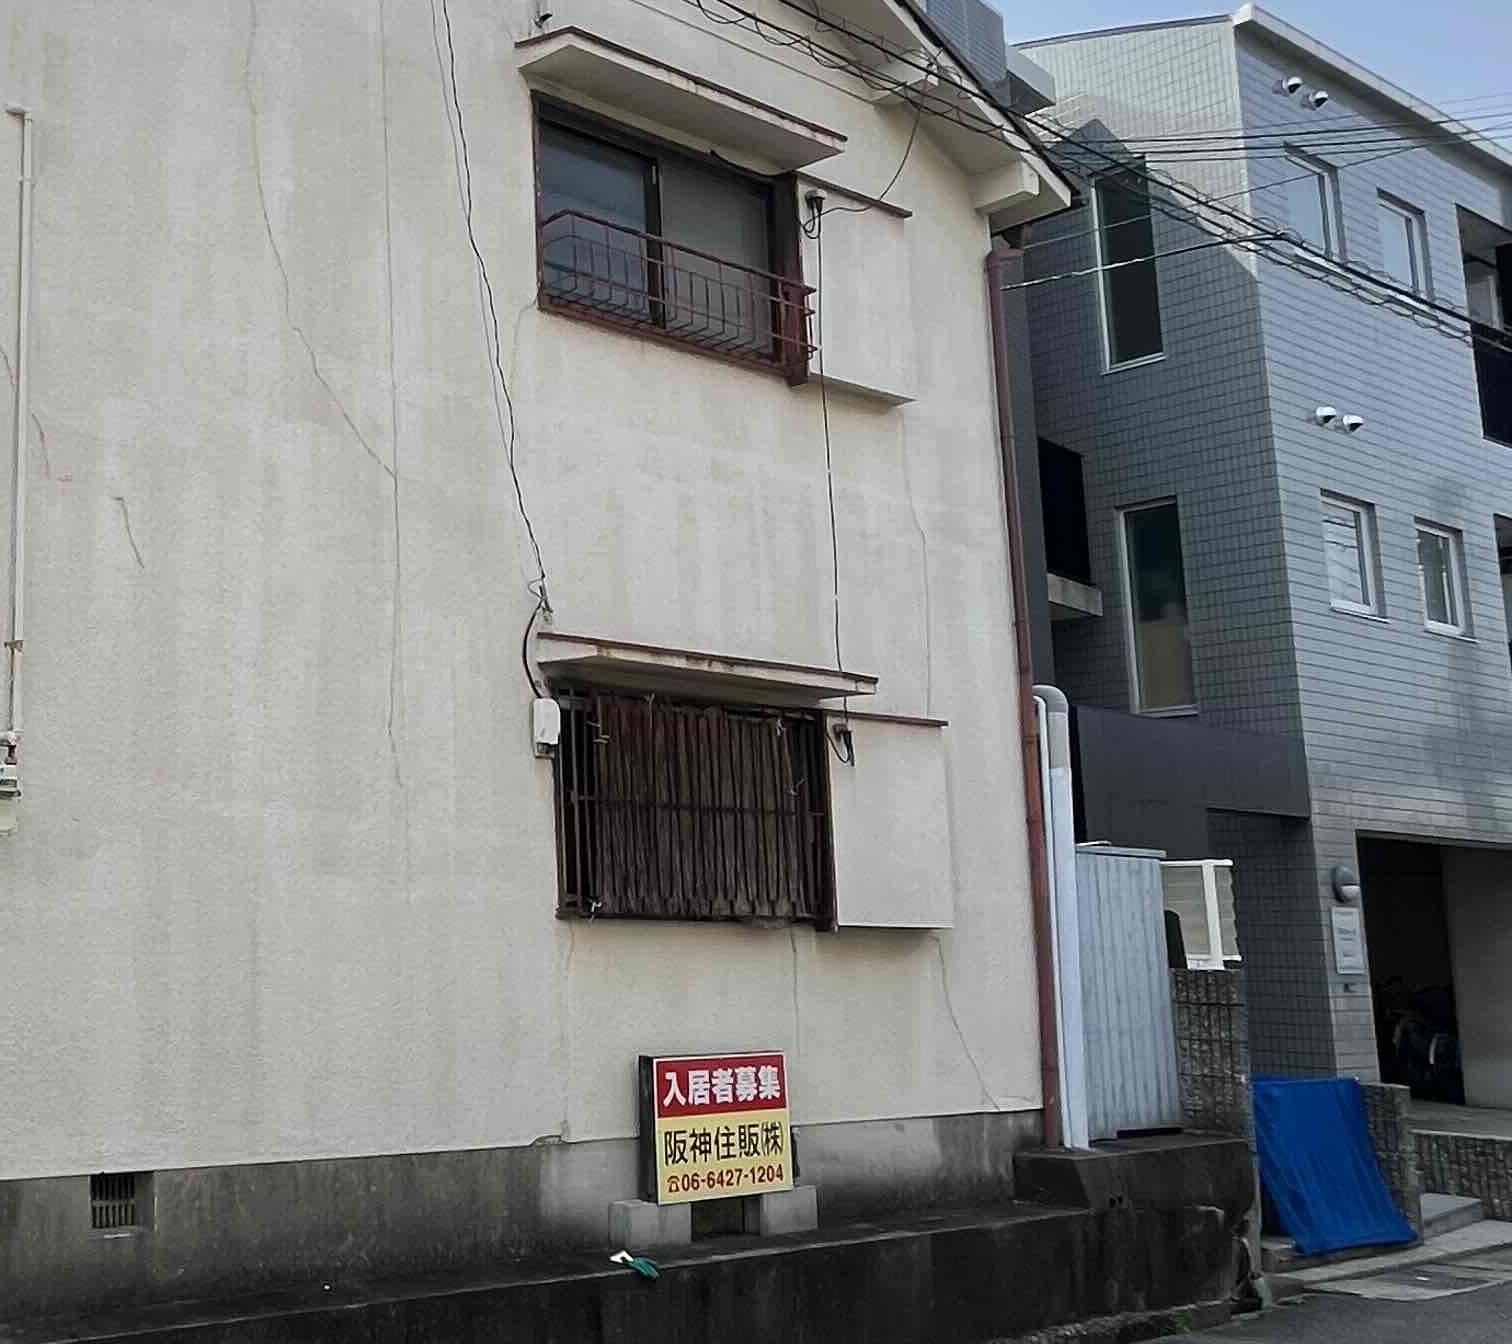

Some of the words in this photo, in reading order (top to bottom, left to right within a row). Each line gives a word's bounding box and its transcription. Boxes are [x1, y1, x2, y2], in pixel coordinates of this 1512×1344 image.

[663, 1065, 782, 1107] 入居者募集
[681, 1164, 784, 1192] 06-6427-1204
